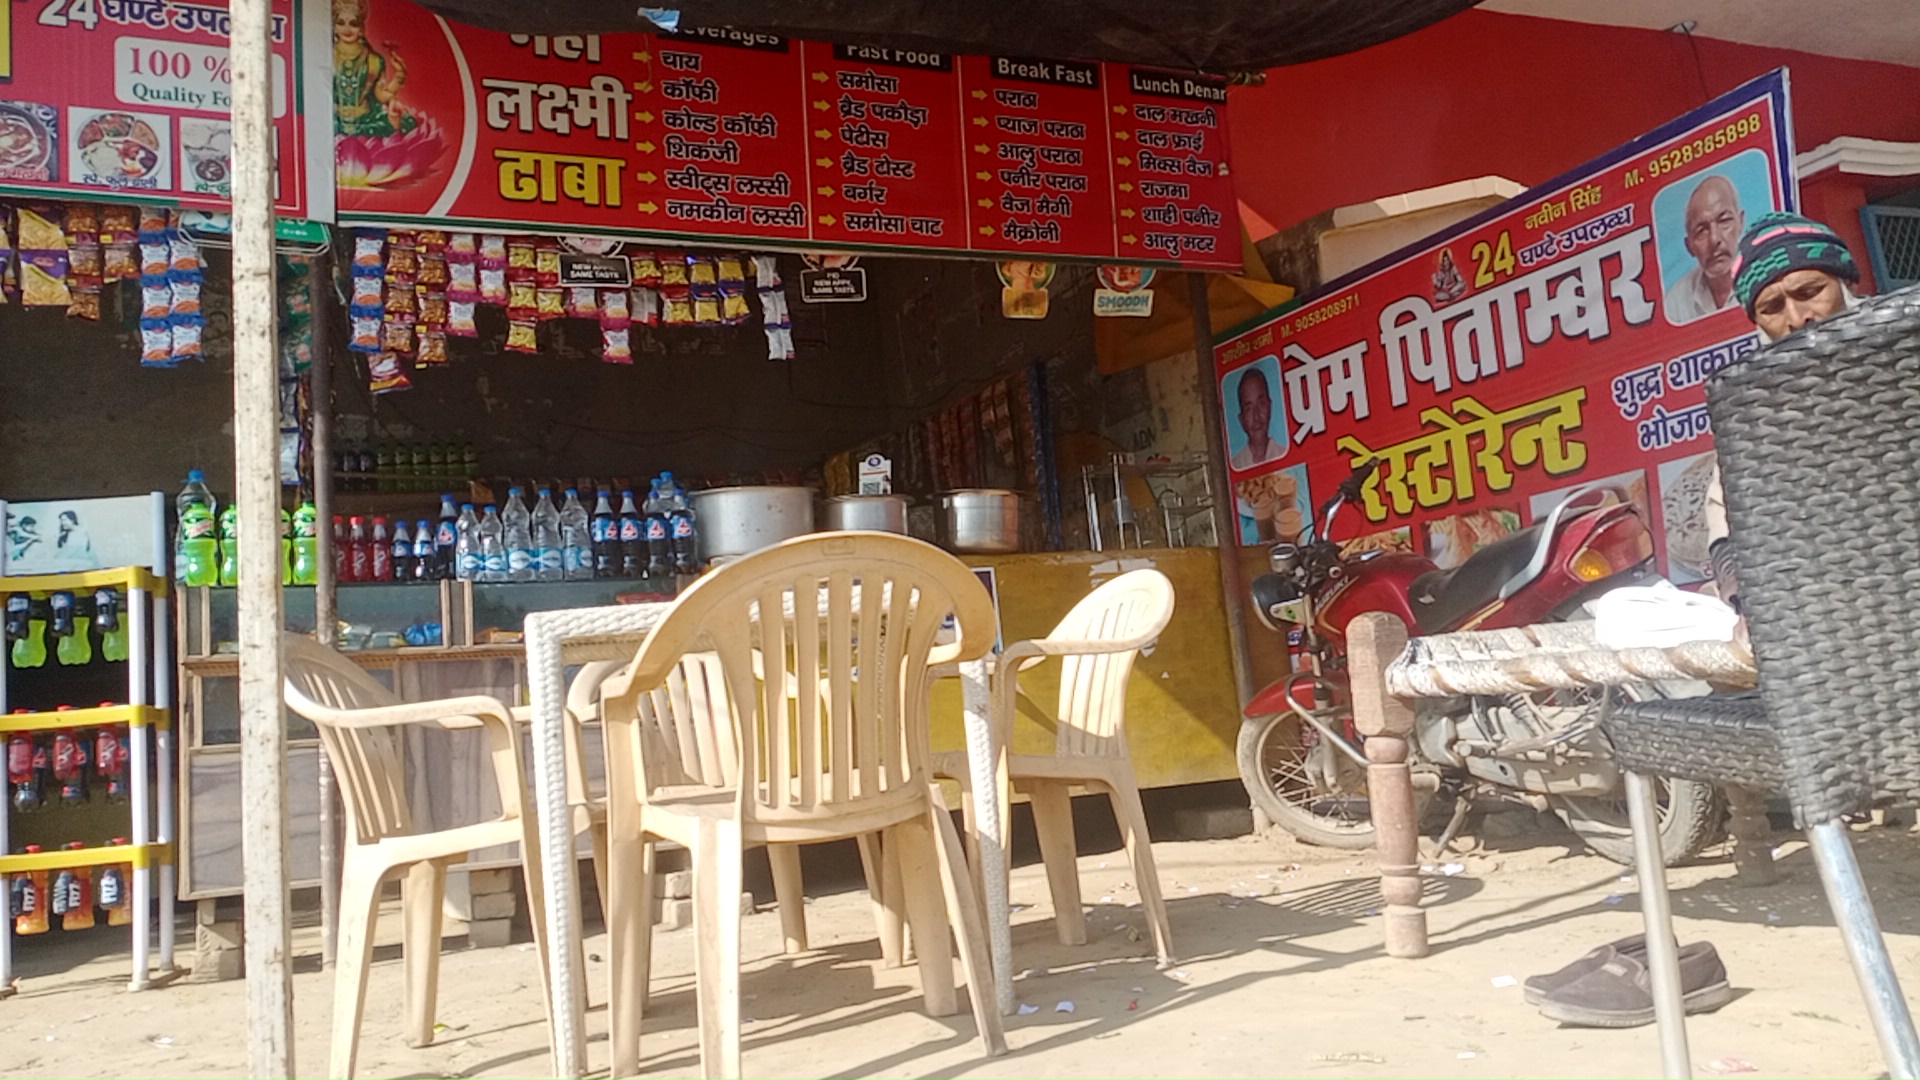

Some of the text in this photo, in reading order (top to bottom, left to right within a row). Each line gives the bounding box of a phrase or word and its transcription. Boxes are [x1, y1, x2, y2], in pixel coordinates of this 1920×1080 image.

[129, 47, 191, 79] 100
[660, 51, 702, 73] चाय
[847, 44, 941, 66] Fast Food
[837, 68, 899, 94] समोसा
[997, 57, 1093, 85] Break Fast
[132, 82, 232, 108] Quality Fo
[662, 77, 719, 104] कॉफी
[993, 88, 1039, 110] पराठा
[1132, 74, 1227, 100] Lunch Denar
[481, 75, 633, 140] लक्ष्मी
[1133, 104, 1218, 129] दाल मखनी
[663, 106, 778, 138] कोल्ड कॉफी
[839, 122, 889, 149] पेटीस
[995, 115, 1086, 140] प्याज पराठा
[664, 134, 741, 165] शिकंजी
[1136, 129, 1204, 154] दाल फ्राई
[873, 154, 915, 179] टोस्ट
[1038, 145, 1083, 166] पराठा
[1137, 149, 1183, 175] मिक्स
[494, 148, 627, 207] ढाबा
[665, 164, 791, 198] स्वीट्स लस्सी
[998, 166, 1088, 194] पनीर पराठा
[1524, 113, 1762, 229] नवीन सिंह M. 9528385898
[1139, 180, 1189, 200] राजमा
[666, 198, 807, 228] नमकीन लस्सी
[1035, 193, 1073, 218] मैगी
[1142, 202, 1221, 228] शाही पनीर
[843, 208, 944, 237] समोसा चाट
[1182, 233, 1216, 253] मटर
[1471, 203, 1635, 288] 24 घण्टे उपलब्ध
[1097, 295, 1149, 308] SMOODH
[1280, 323, 1294, 338] M.
[1295, 292, 1361, 332] 9058208971
[1282, 224, 1656, 444] प्रेम पिताम्बर
[1612, 363, 1664, 419] शुद्ध
[1336, 386, 1588, 523] रेस्टोरेन्ट
